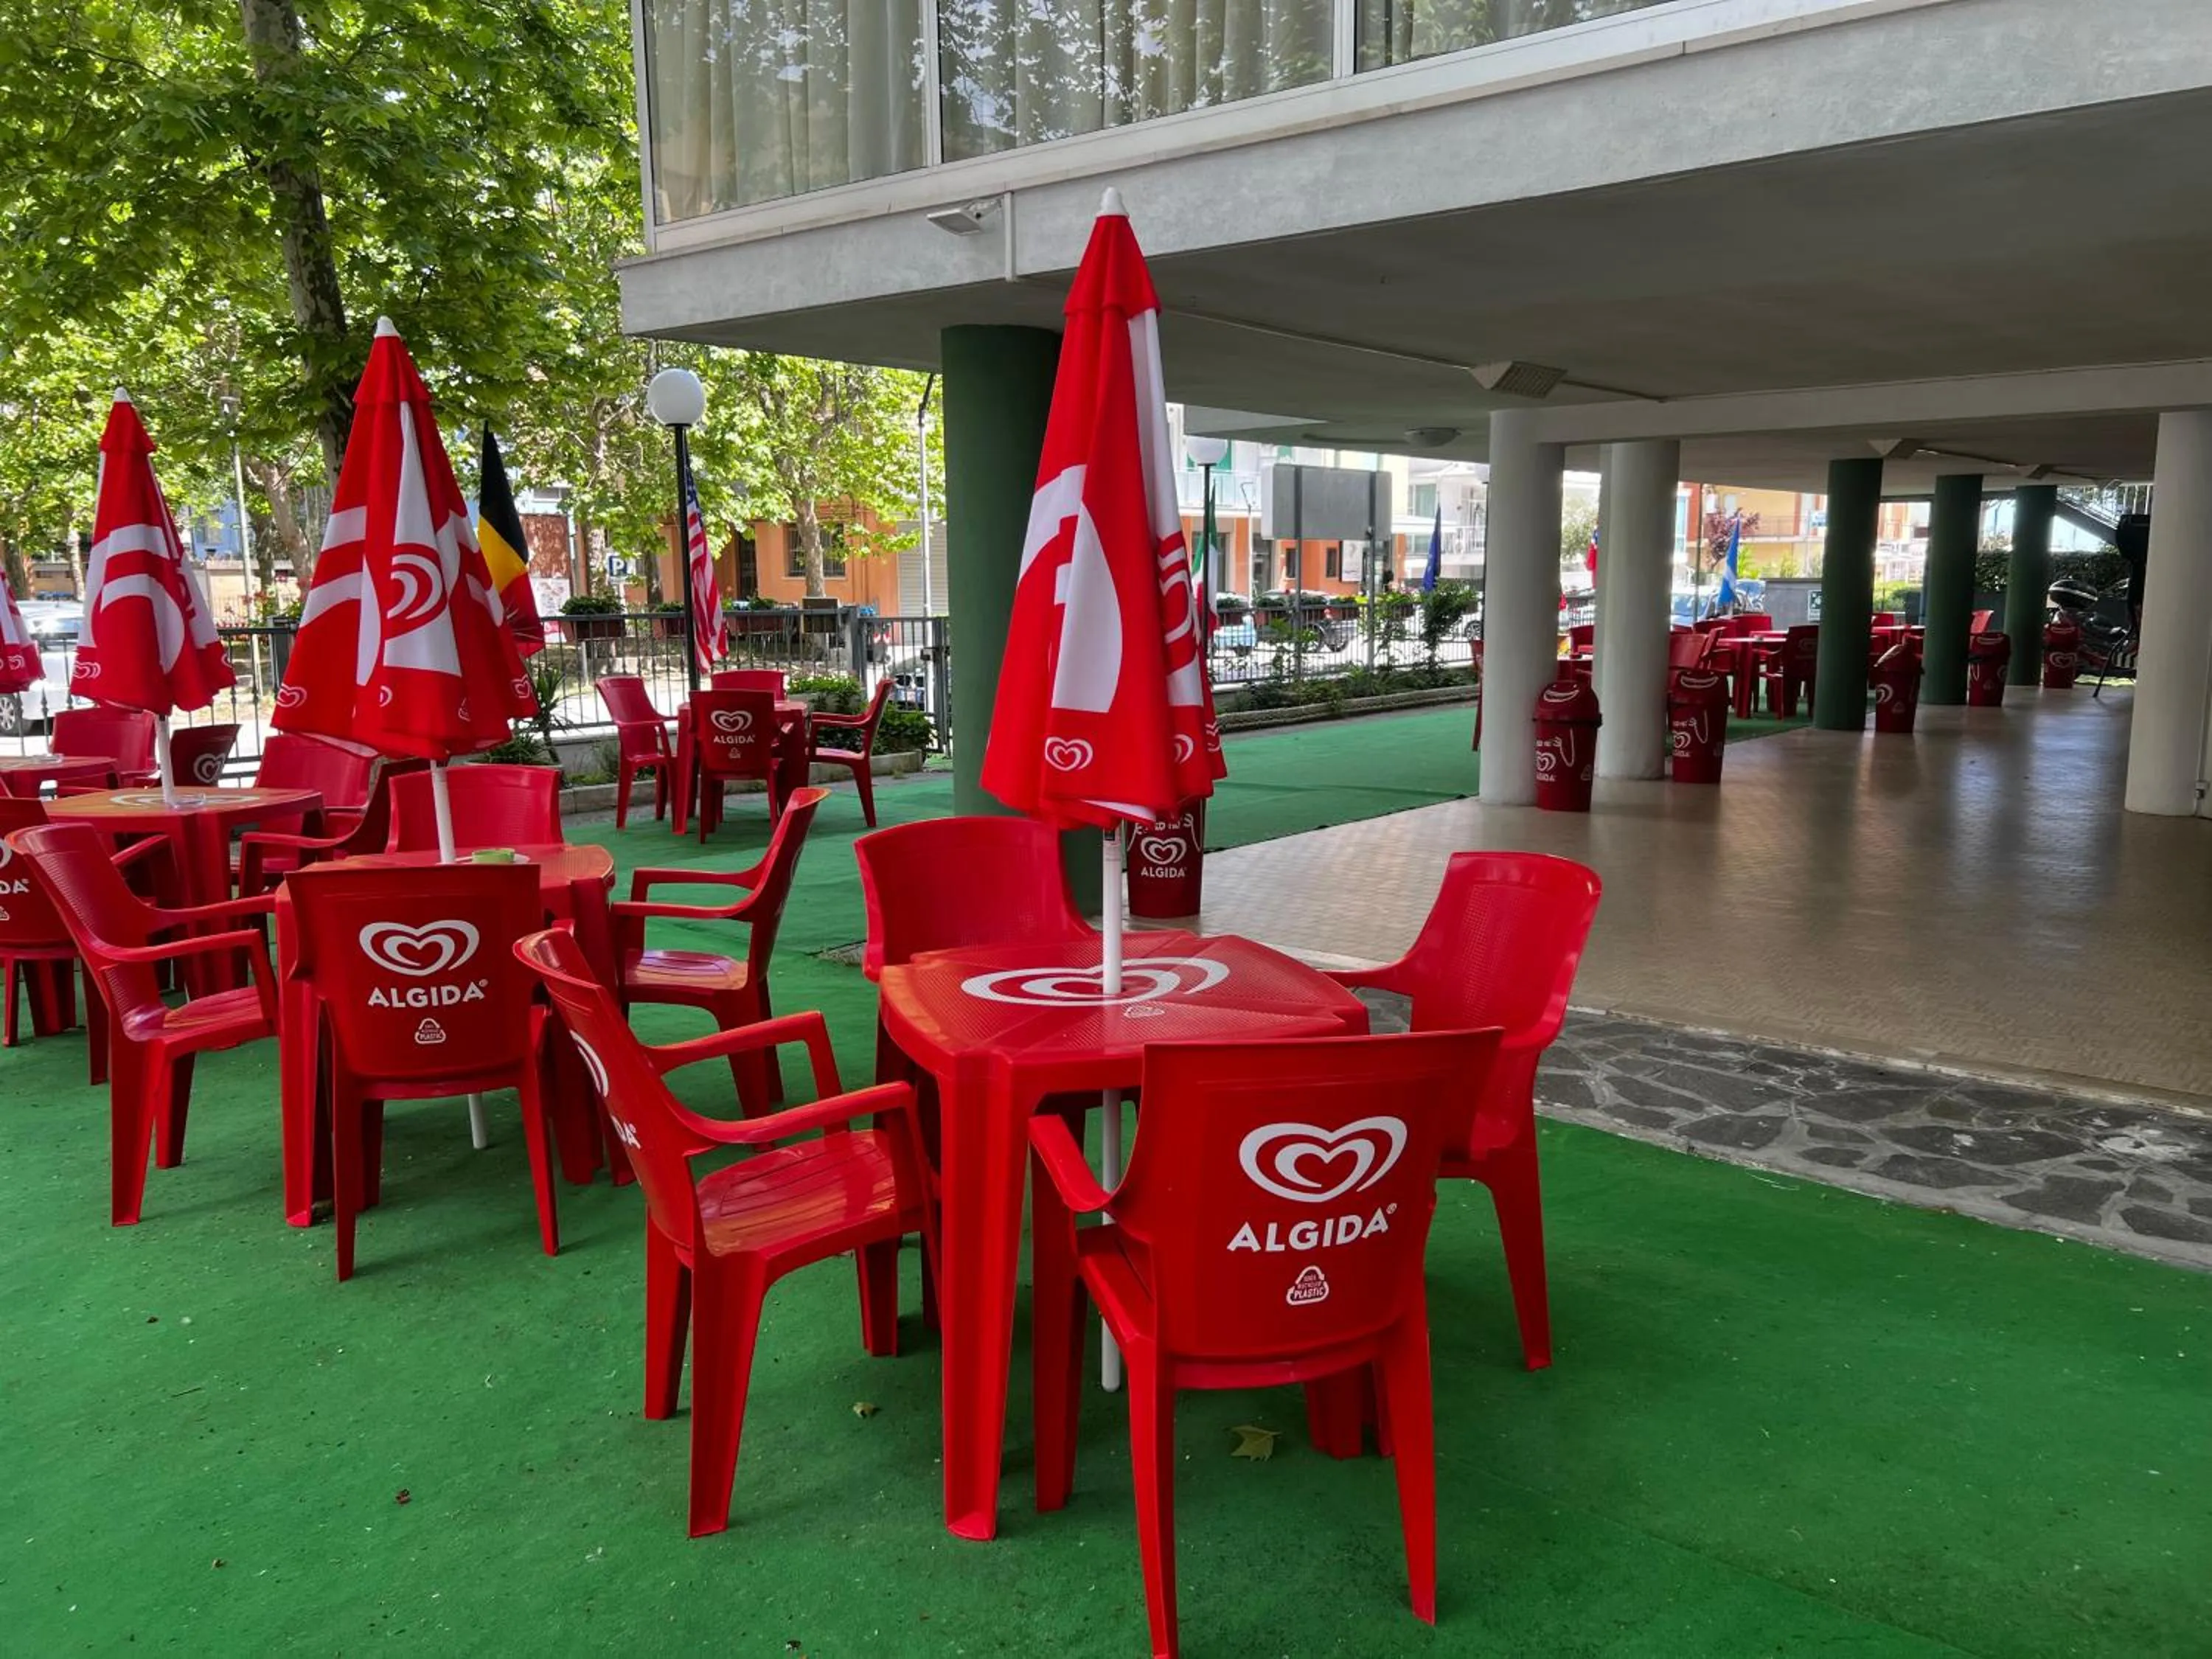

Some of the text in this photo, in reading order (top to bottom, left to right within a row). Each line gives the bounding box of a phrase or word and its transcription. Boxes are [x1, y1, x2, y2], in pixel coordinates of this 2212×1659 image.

[612, 557, 625, 575] P
[713, 735, 754, 744] ALGIDA
[1141, 867, 1186, 878] ALGIDA
[368, 981, 485, 1008] ALGIDA
[1226, 1206, 1389, 1252] ALGIDA
